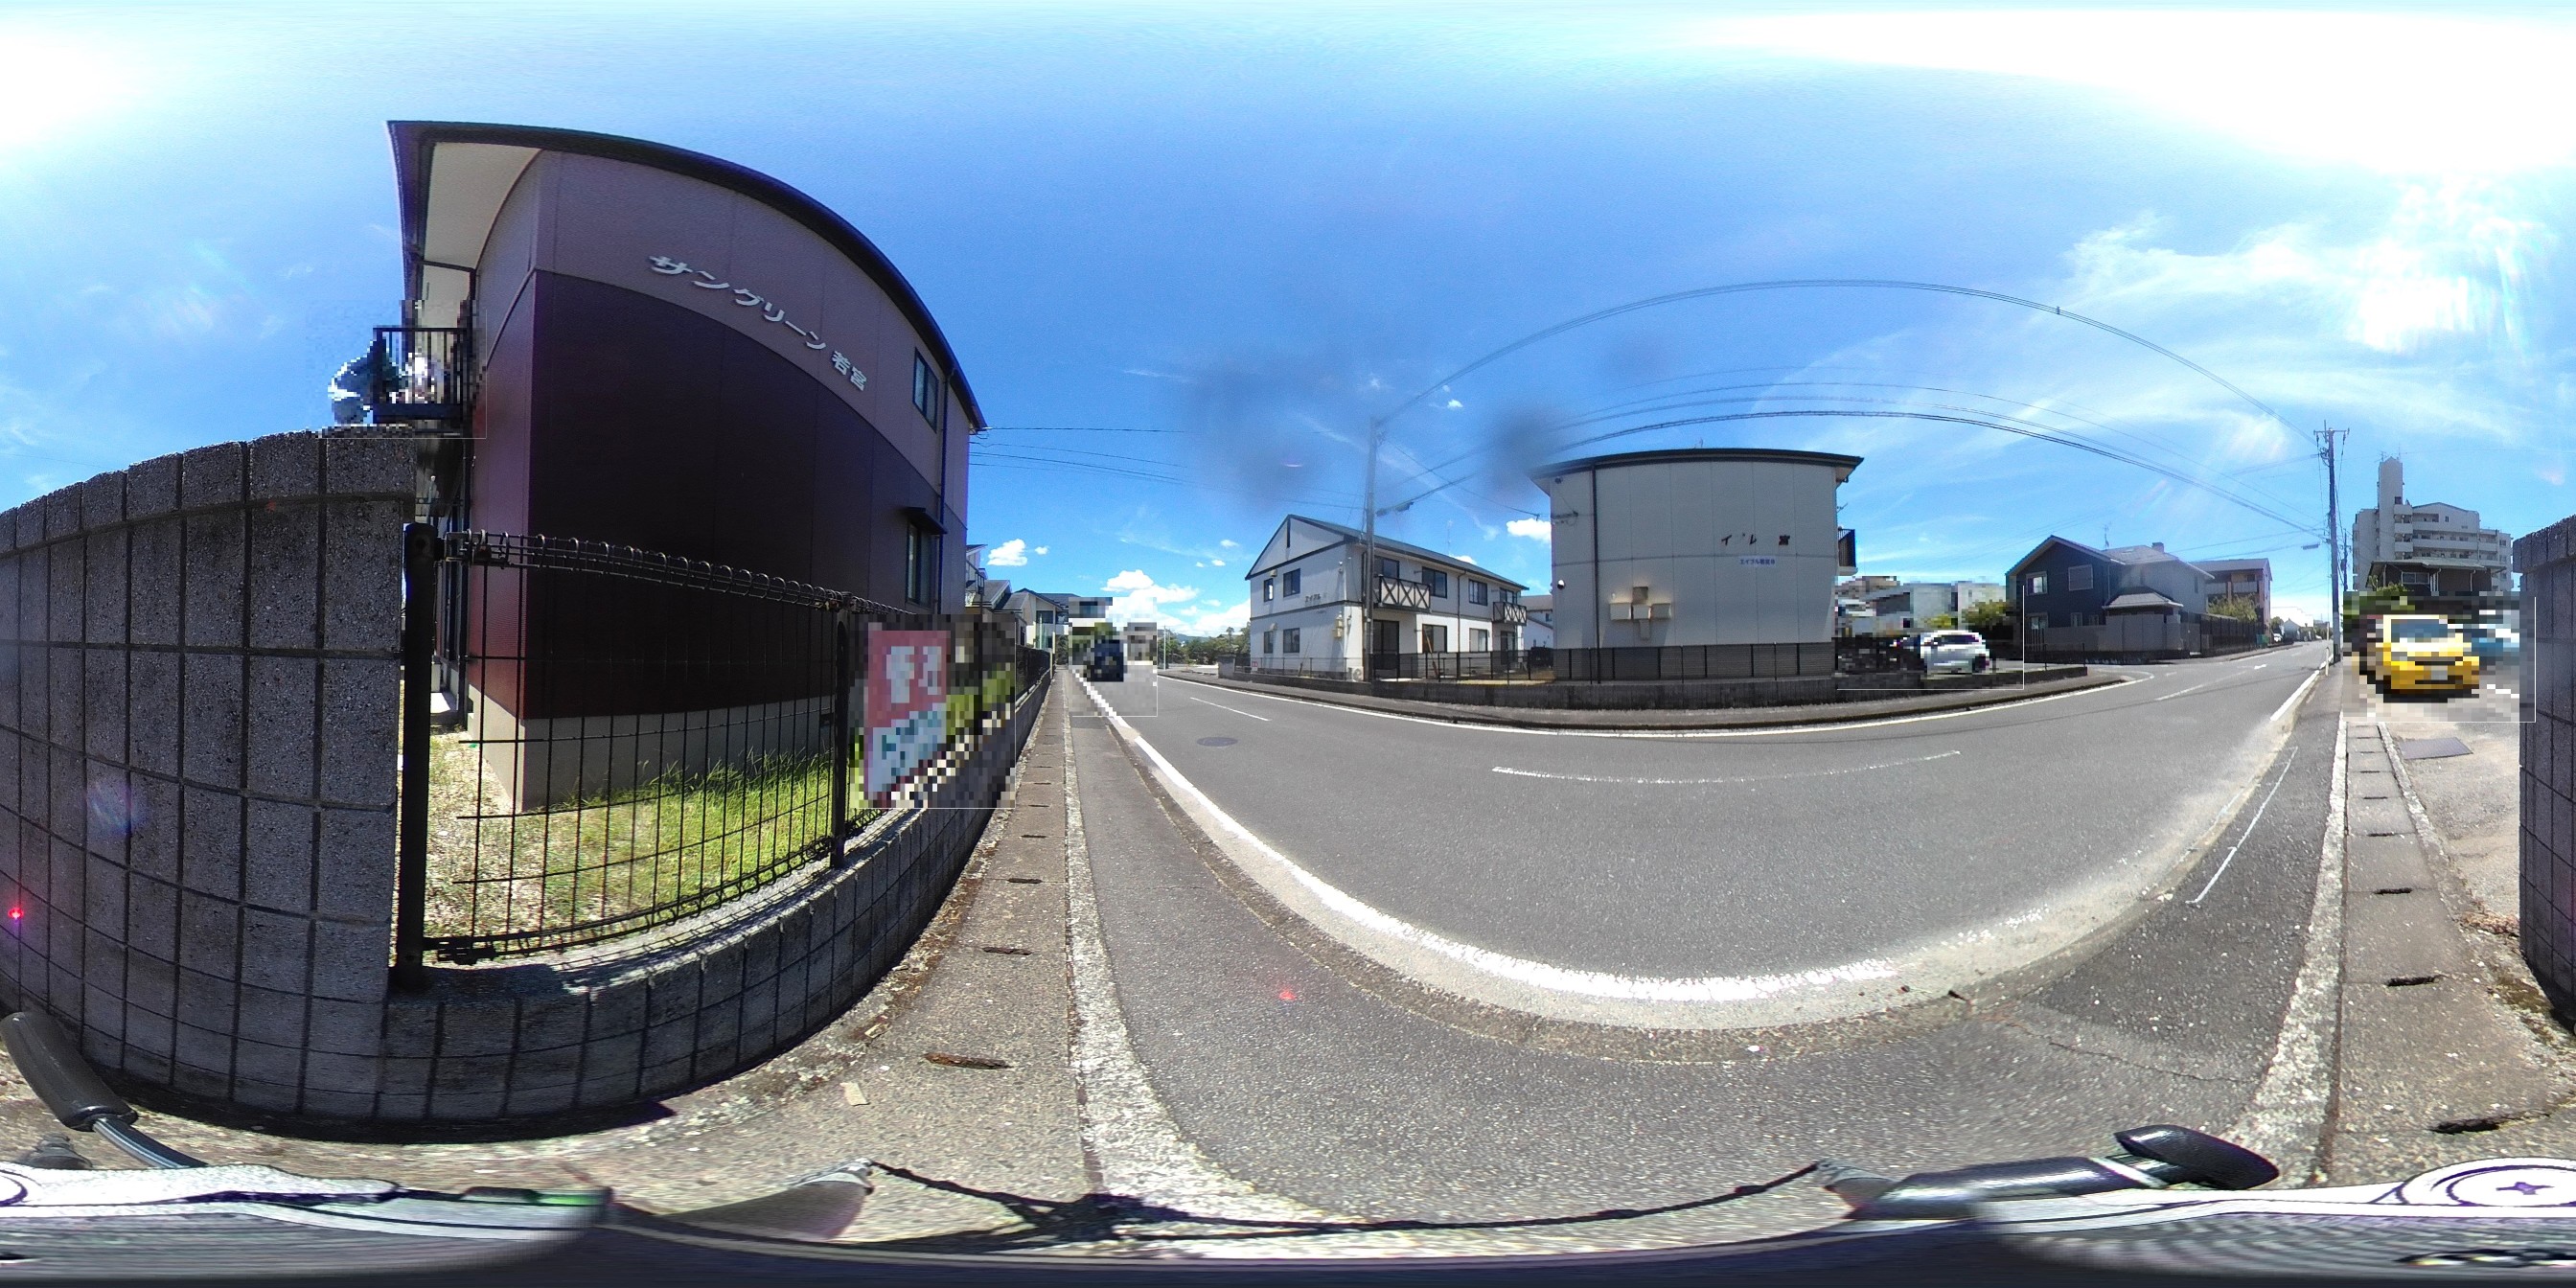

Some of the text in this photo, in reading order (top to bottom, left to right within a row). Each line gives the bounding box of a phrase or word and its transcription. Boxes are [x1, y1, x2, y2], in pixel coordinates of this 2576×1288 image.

[648, 255, 867, 392] サングリーン 若宮
